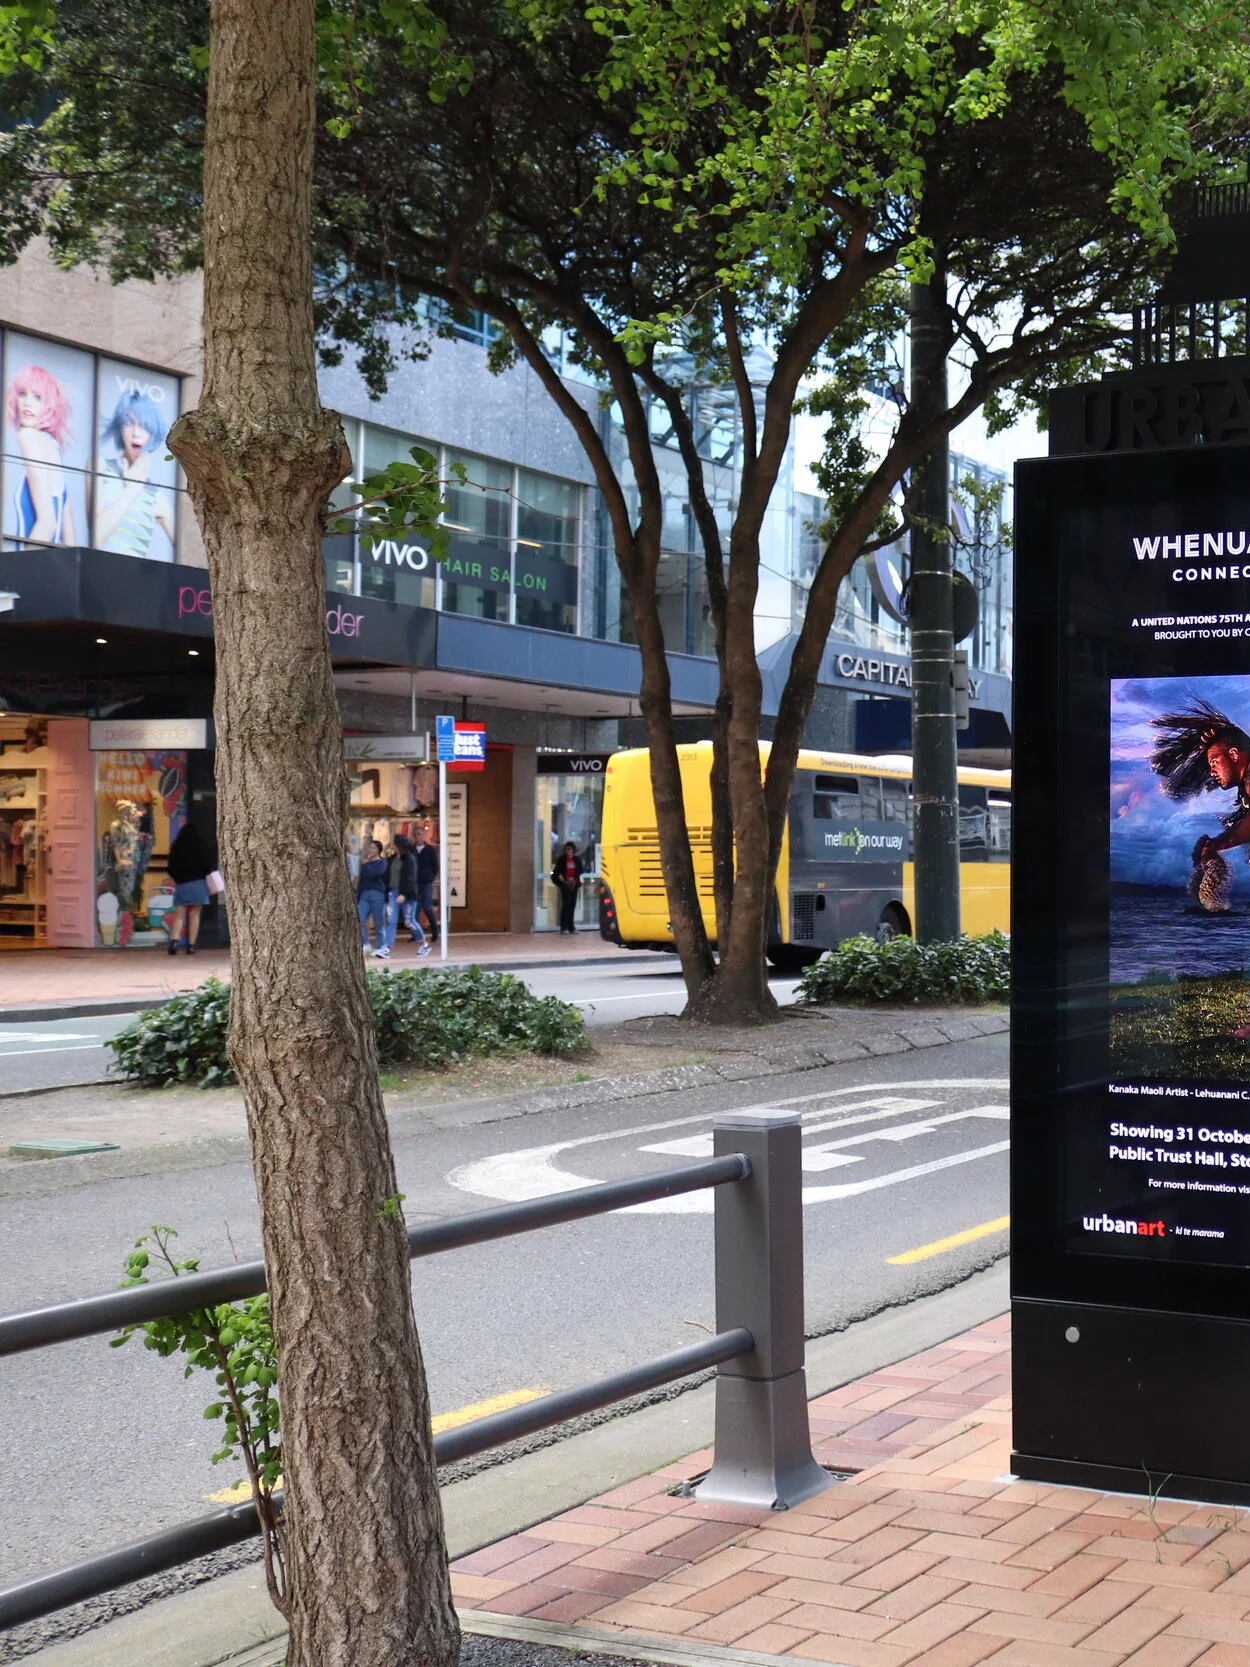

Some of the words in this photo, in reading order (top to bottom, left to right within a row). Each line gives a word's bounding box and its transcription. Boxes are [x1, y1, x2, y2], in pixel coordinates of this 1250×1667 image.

[115, 375, 165, 402] VIVO
[371, 535, 428, 571] VIVO
[1132, 618, 1139, 627] A
[1141, 616, 1175, 627] UNITED
[1176, 615, 1217, 625] NATIONS
[1219, 613, 1243, 624] 75TH
[1154, 630, 1197, 641] BROUGHT
[1198, 629, 1210, 639] TO
[1211, 628, 1230, 639] YOU
[1232, 627, 1244, 637] BY
[454, 746, 483, 756] eans
[570, 760, 602, 771] VIVO
[824, 832, 856, 847] metlink
[885, 836, 903, 850] way
[1108, 1084, 1139, 1095] Kanaka
[1140, 1086, 1164, 1096] Maoli
[1165, 1087, 1189, 1097] Artist
[1195, 1089, 1240, 1100] Lehuanani
[1241, 1091, 1250, 1100] C.
[1110, 1123, 1173, 1142] Showing
[1176, 1127, 1194, 1141] 31
[1109, 1145, 1153, 1161] Public
[1154, 1149, 1192, 1164] Trust
[1195, 1151, 1228, 1168] Hall,
[1148, 1179, 1162, 1188] For
[1163, 1181, 1186, 1190] more
[1187, 1181, 1236, 1193] information
[1083, 1214, 1165, 1237] urbanart
[1183, 1227, 1191, 1236] te
[1192, 1228, 1225, 1239] marama
